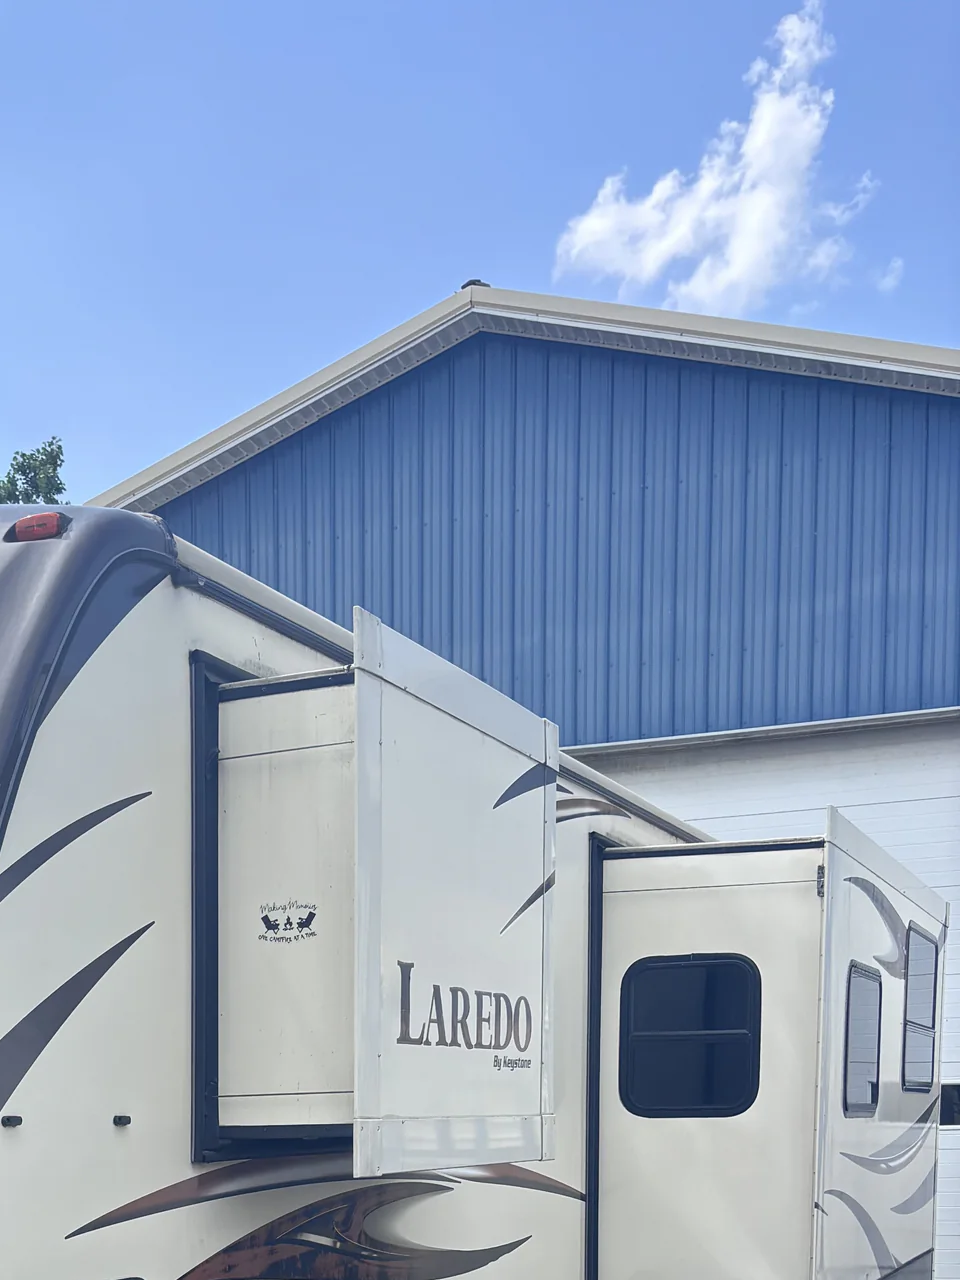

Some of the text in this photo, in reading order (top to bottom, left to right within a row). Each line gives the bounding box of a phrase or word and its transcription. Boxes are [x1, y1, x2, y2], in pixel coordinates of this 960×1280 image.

[260, 902, 288, 914] Making
[396, 959, 533, 1053] LAREDO
[493, 1054, 532, 1071] By Keystone
